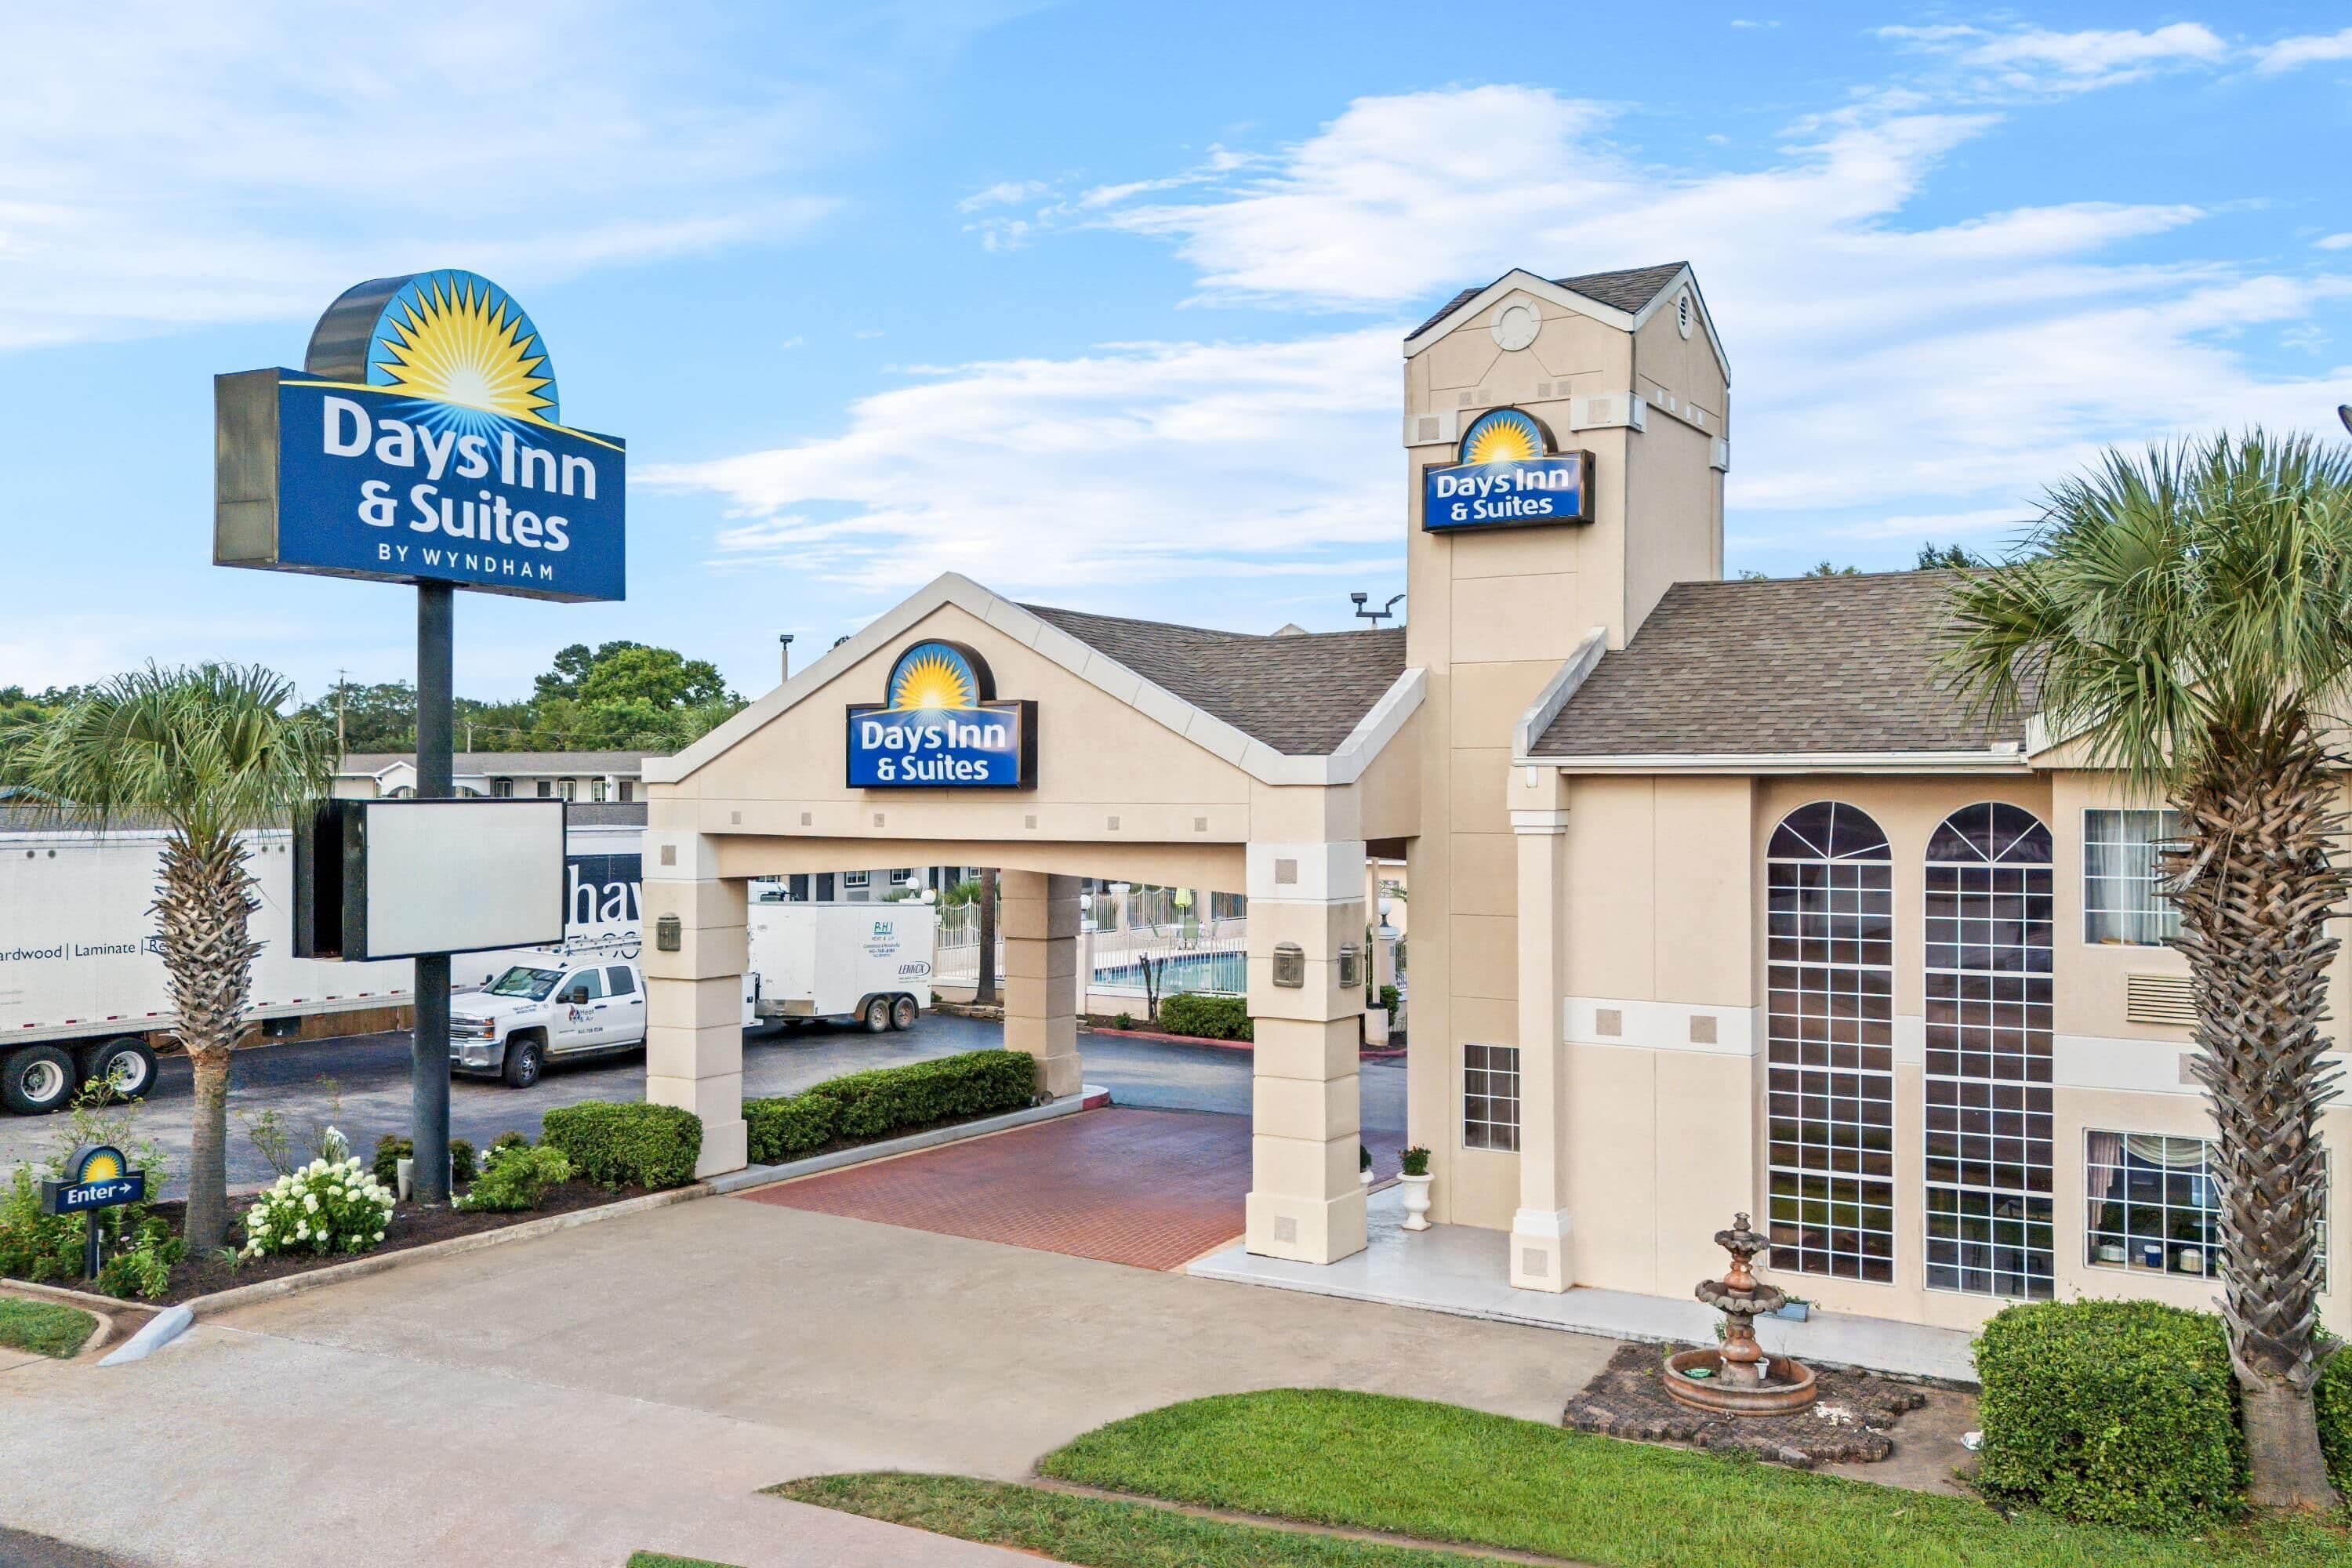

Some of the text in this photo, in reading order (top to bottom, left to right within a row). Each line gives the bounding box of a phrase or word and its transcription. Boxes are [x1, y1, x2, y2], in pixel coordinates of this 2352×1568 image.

[323, 394, 597, 501] Days Inn
[1436, 468, 1569, 499] Days Inn
[358, 480, 570, 553] & Suites
[1450, 495, 1553, 521] & Suites
[379, 543, 554, 582] BY WYNDHAM
[862, 720, 1006, 753] Days Inn
[877, 753, 989, 781] & Suites
[568, 864, 642, 924] ha
[0, 945, 63, 961] ardwood
[75, 943, 136, 957] Laminate
[898, 964, 925, 975] LENNOX
[67, 1185, 117, 1204] Enter
